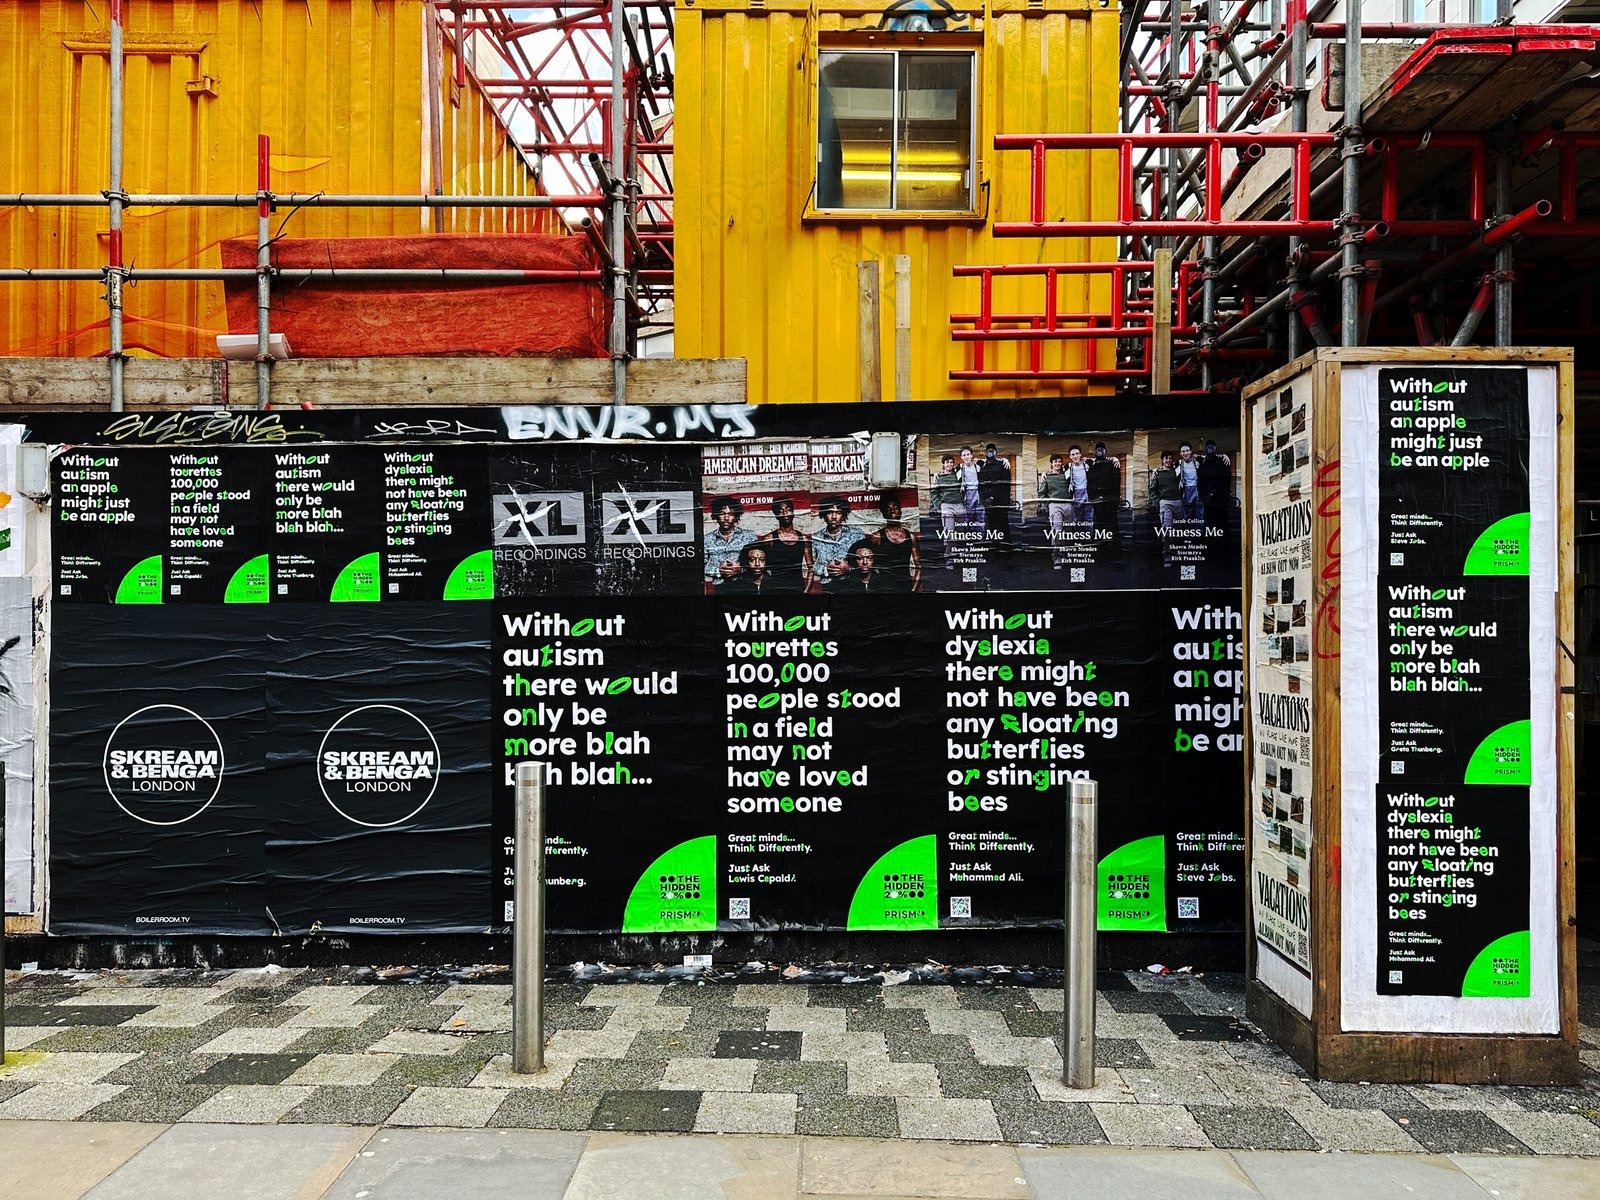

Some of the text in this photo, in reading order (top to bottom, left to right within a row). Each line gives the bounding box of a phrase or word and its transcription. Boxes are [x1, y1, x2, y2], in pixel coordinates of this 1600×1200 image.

[1390, 377, 1467, 393] Without
[1390, 395, 1454, 411] autism
[1391, 414, 1466, 432] an apple
[1391, 433, 1482, 452] might just
[61, 454, 119, 467] Without
[170, 454, 218, 464] Without
[275, 453, 330, 465] Without
[384, 452, 433, 462] Without
[812, 455, 864, 473] AMERICAN
[1390, 452, 1490, 471] be an apple
[170, 467, 222, 476] tourettes
[385, 463, 432, 477] dyslexia
[704, 458, 757, 474] AMERICAN
[759, 456, 794, 472] DREAM
[61, 468, 109, 480] autism
[276, 466, 321, 479] autism
[171, 479, 218, 490] 100,000
[275, 480, 354, 492] there would
[385, 475, 453, 487] there might
[61, 482, 118, 495] an apple
[61, 496, 130, 510] might just
[171, 490, 250, 503] people stood
[276, 494, 322, 508] only be
[276, 507, 342, 519] more blah
[387, 510, 449, 522] butterflies
[502, 501, 577, 537] XL
[611, 500, 686, 536] XL
[276, 521, 344, 533] blah blah...
[1259, 500, 1311, 546] VACATIONS
[936, 529, 1004, 540] Witness Me
[1043, 529, 1113, 540] Witness Me
[1154, 526, 1224, 538] Witness Me
[387, 536, 415, 545] bees
[494, 548, 586, 560] RECORDINGS
[603, 546, 695, 559] RECORDINGS
[1389, 584, 1466, 600] Without
[1389, 603, 1452, 619] autism
[503, 612, 625, 636] Without
[725, 610, 831, 631] Without
[945, 608, 1053, 629] Without
[1389, 622, 1497, 637] there would
[503, 641, 603, 667] autism
[725, 639, 838, 658] tourettes
[946, 633, 1049, 661] dyslexia
[1390, 640, 1453, 659] only be
[946, 659, 1096, 686] there might
[1391, 659, 1480, 673] more blah
[727, 663, 830, 687] 100,000
[503, 671, 677, 696] there would
[1391, 677, 1482, 691] blah blah...
[727, 687, 900, 714] people stood
[947, 686, 1129, 707] not have been
[504, 702, 607, 732] only be
[1259, 692, 1309, 733] VACATIONS
[727, 716, 832, 738] in a field
[947, 718, 995, 738] any
[505, 731, 650, 756] more blah
[948, 737, 1085, 759] butterflies
[110, 750, 217, 764] SKREAM
[324, 751, 433, 765] SKREAM
[728, 742, 832, 766] may not
[1260, 742, 1298, 763] ALBUM OUT NOW
[111, 764, 216, 778] & BENGA
[324, 766, 432, 779] & BENGA
[505, 762, 652, 785] bh blah...
[728, 765, 867, 787] have loved
[947, 769, 980, 785] or
[132, 781, 195, 791] LONDON
[347, 782, 411, 792] LONDON
[728, 797, 842, 813] someone
[949, 791, 1008, 811] bees
[1387, 793, 1455, 807] Without
[1388, 809, 1452, 826] dyslexia
[728, 834, 756, 842] Great
[949, 832, 977, 840] Great
[1387, 825, 1481, 843] there might
[728, 843, 754, 852] Think
[949, 842, 975, 850] Think
[1389, 843, 1498, 856] not have been
[728, 864, 770, 872] Just Ask
[950, 862, 991, 871] Just Ask
[1388, 861, 1418, 874] any
[1008, 873, 1023, 881] Ali.
[1389, 874, 1474, 888] butterflies
[1258, 870, 1308, 932] VACATIONS
[1389, 889, 1477, 907] or stinging
[1389, 907, 1426, 919] bees
